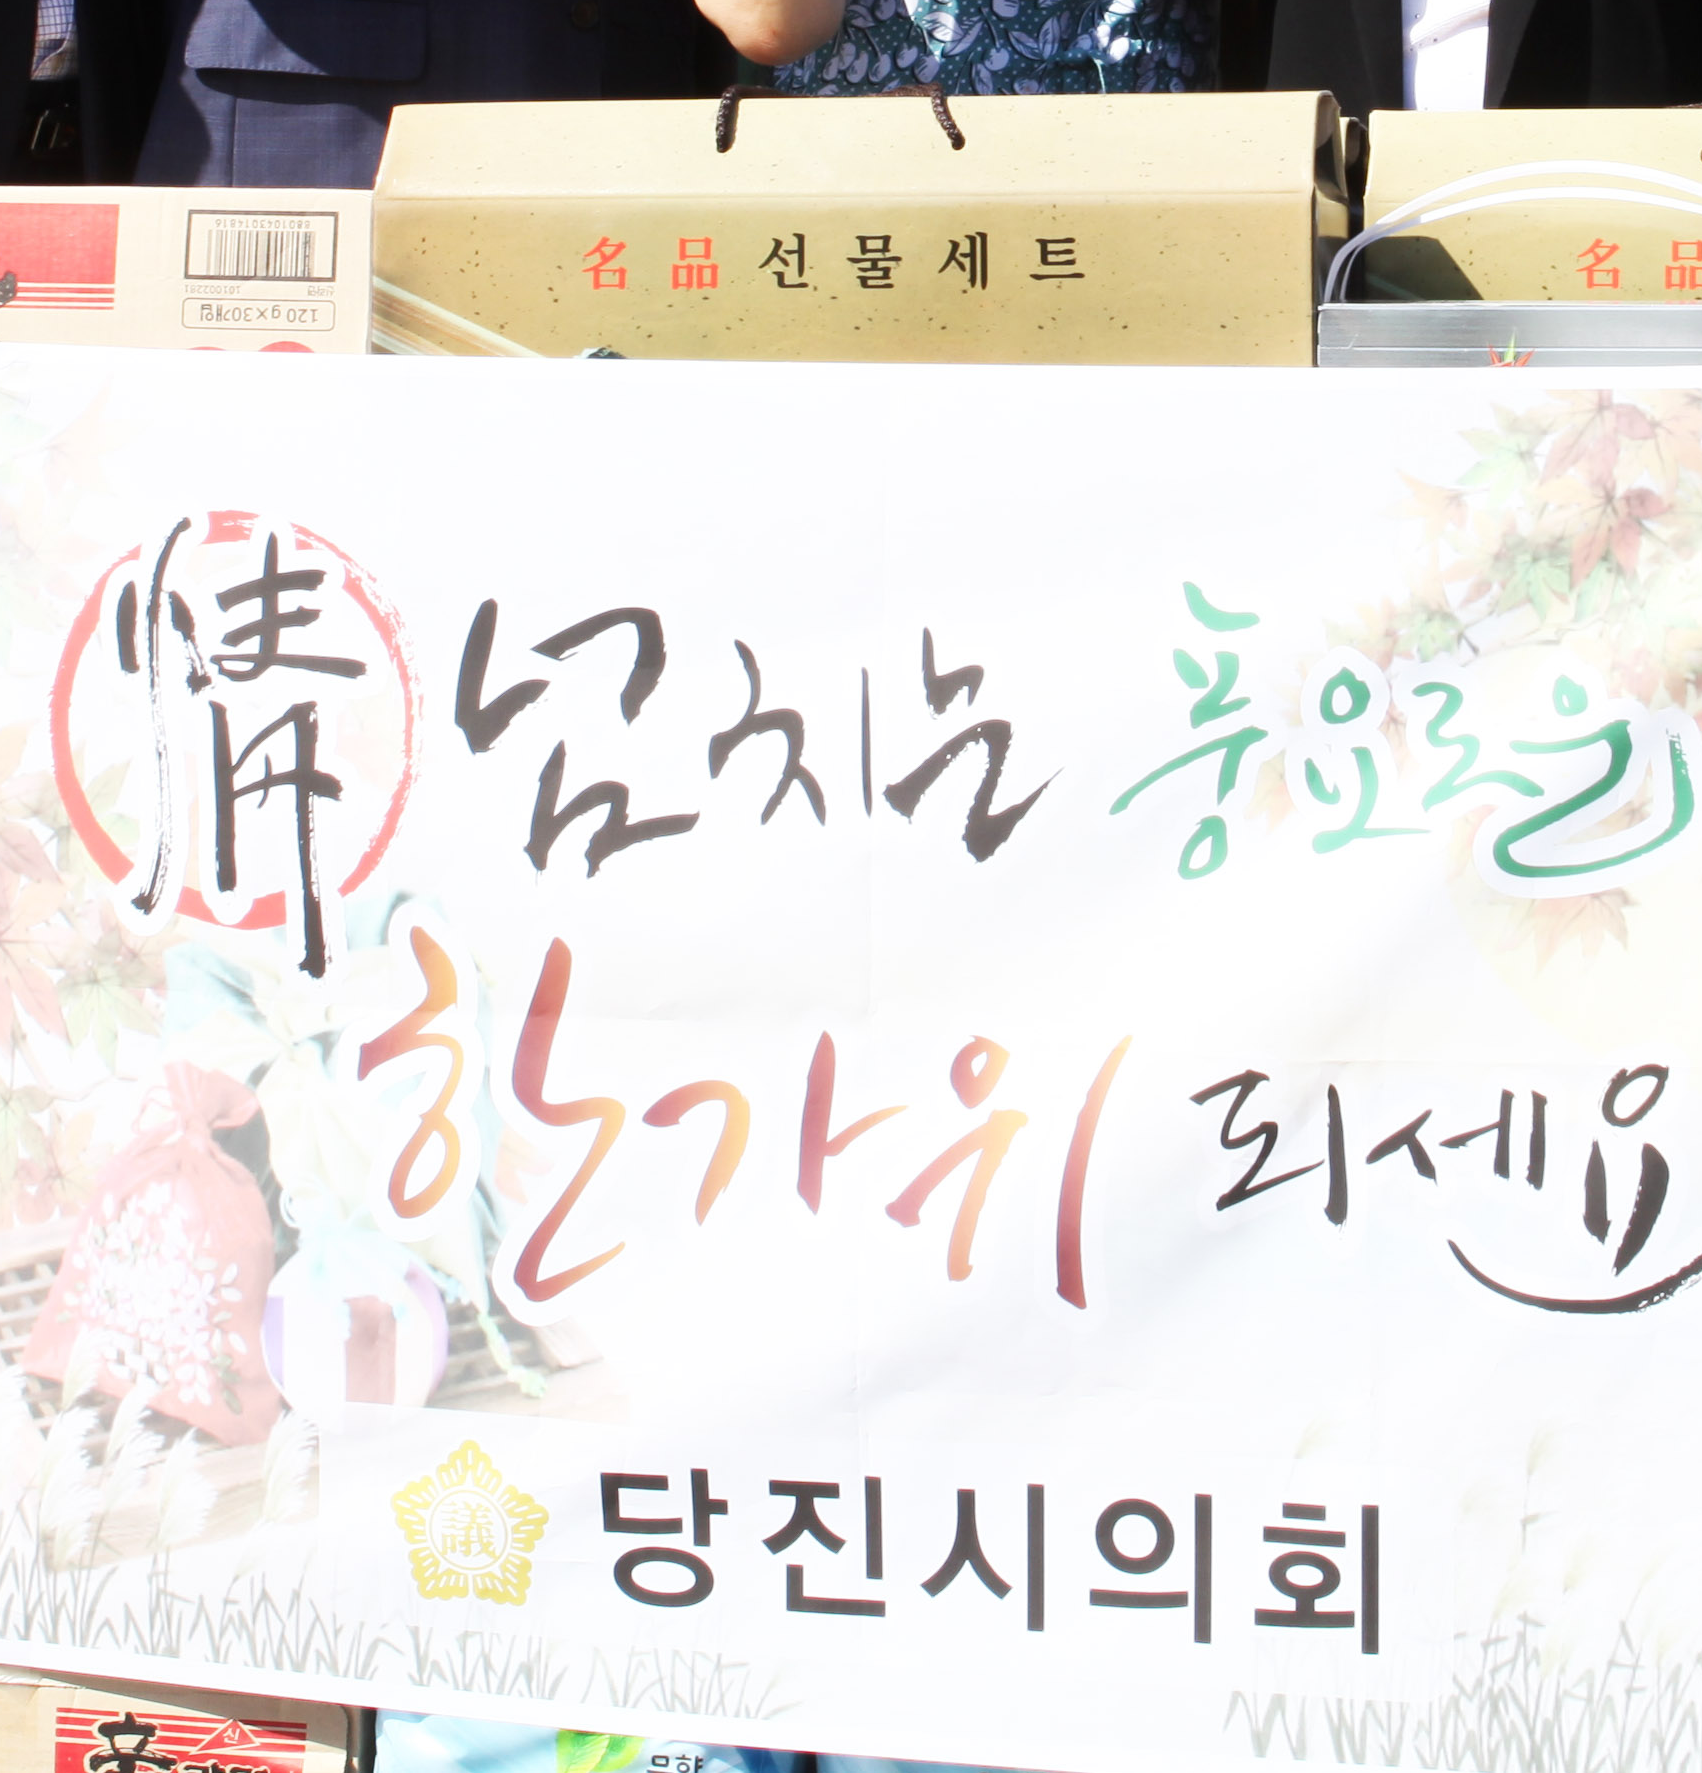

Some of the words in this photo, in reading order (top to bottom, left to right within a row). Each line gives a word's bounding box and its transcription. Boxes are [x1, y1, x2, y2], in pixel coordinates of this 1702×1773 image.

[286, 308, 319, 324] 120
[758, 231, 1087, 291] 선물세트
[454, 597, 1063, 877] 넘치는
[1106, 581, 1700, 882] 풍요로운
[356, 926, 1133, 1309] 한가위
[595, 1467, 1382, 1655] 당진시의회
[222, 1727, 240, 1744] 신
